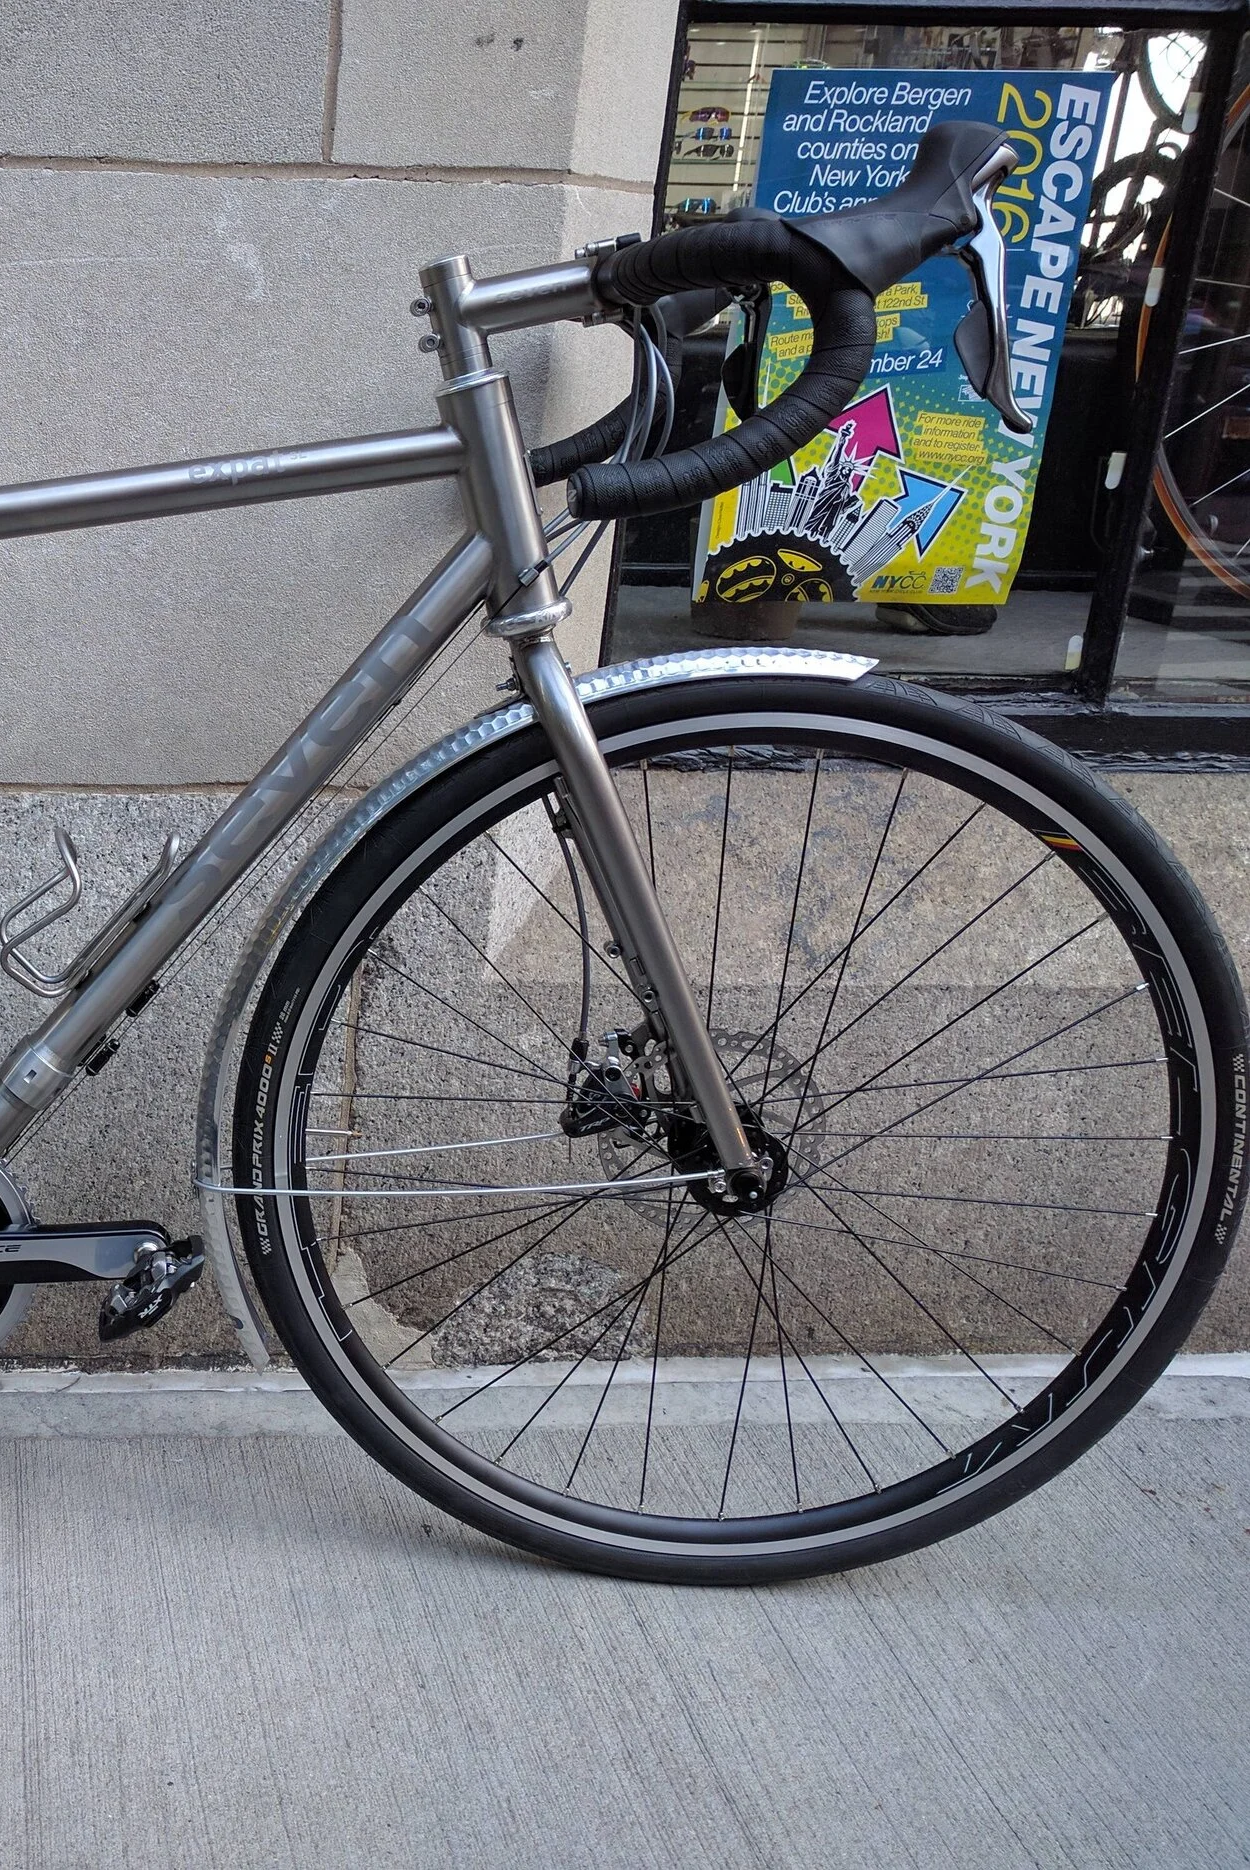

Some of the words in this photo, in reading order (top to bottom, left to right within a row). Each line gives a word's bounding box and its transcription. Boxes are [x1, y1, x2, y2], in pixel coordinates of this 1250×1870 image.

[804, 81, 888, 110] Explore
[891, 82, 972, 110] Bergen
[782, 110, 830, 132] and
[828, 110, 933, 134] Rockland
[797, 138, 888, 160] counties
[890, 143, 920, 161] on
[991, 82, 1052, 243] 2016
[809, 164, 861, 187] New
[865, 165, 911, 188] York
[773, 190, 835, 214] Club's
[1019, 83, 1101, 314] ESCAPE
[882, 296, 913, 309] 122nd
[914, 295, 926, 307] St
[771, 334, 800, 347] Route
[778, 345, 798, 358] and
[916, 347, 943, 370] 24
[917, 413, 936, 424] For
[935, 416, 962, 427] more
[962, 418, 982, 429] ride
[923, 426, 976, 440] information
[913, 438, 932, 448] and
[934, 439, 943, 448] to
[187, 450, 286, 486] expat
[964, 455, 1032, 594] YORK
[871, 575, 927, 592] NYCC
[251, 1119, 265, 1168] PRIX
[1219, 1074, 1247, 1222] CONTINENTAL
[137, 1293, 163, 1319] XTR
